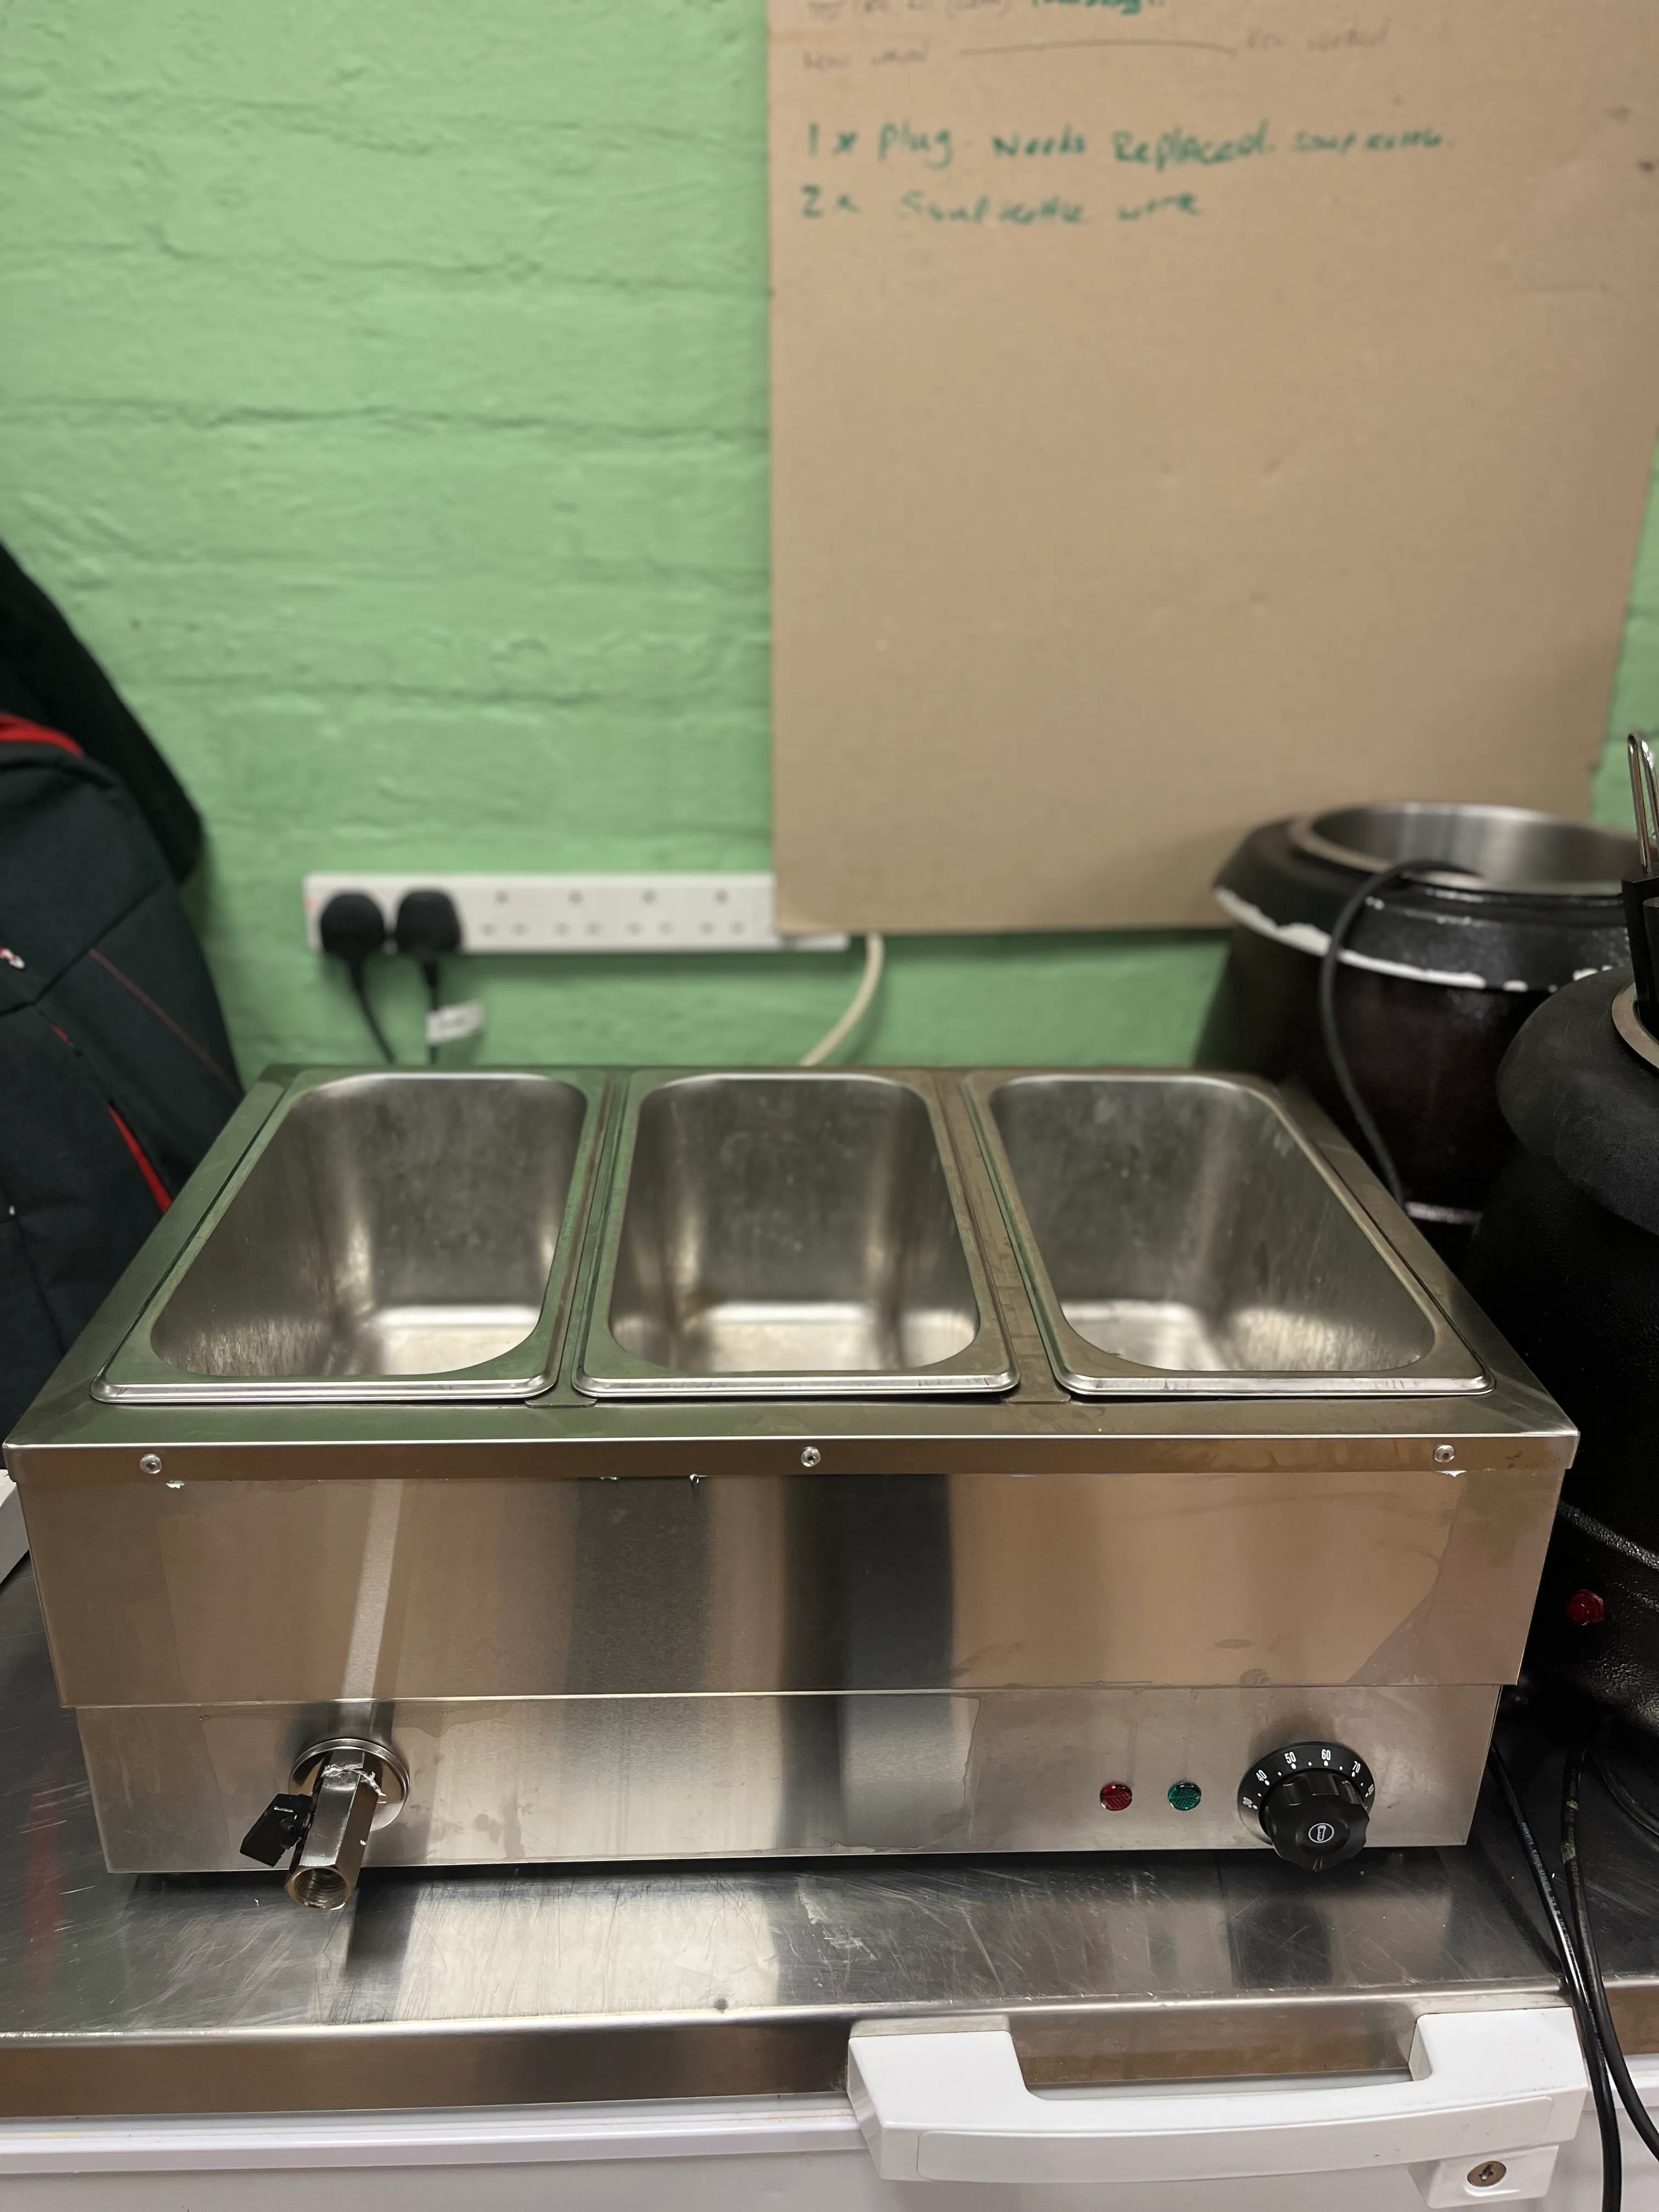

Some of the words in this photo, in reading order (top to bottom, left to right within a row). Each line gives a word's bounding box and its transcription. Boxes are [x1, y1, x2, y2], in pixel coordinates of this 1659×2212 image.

[1256, 1769, 1267, 1781] 40
[1284, 1751, 1297, 1764] 50
[1321, 1748, 1331, 1761] 60
[1352, 1760, 1361, 1773] 70
